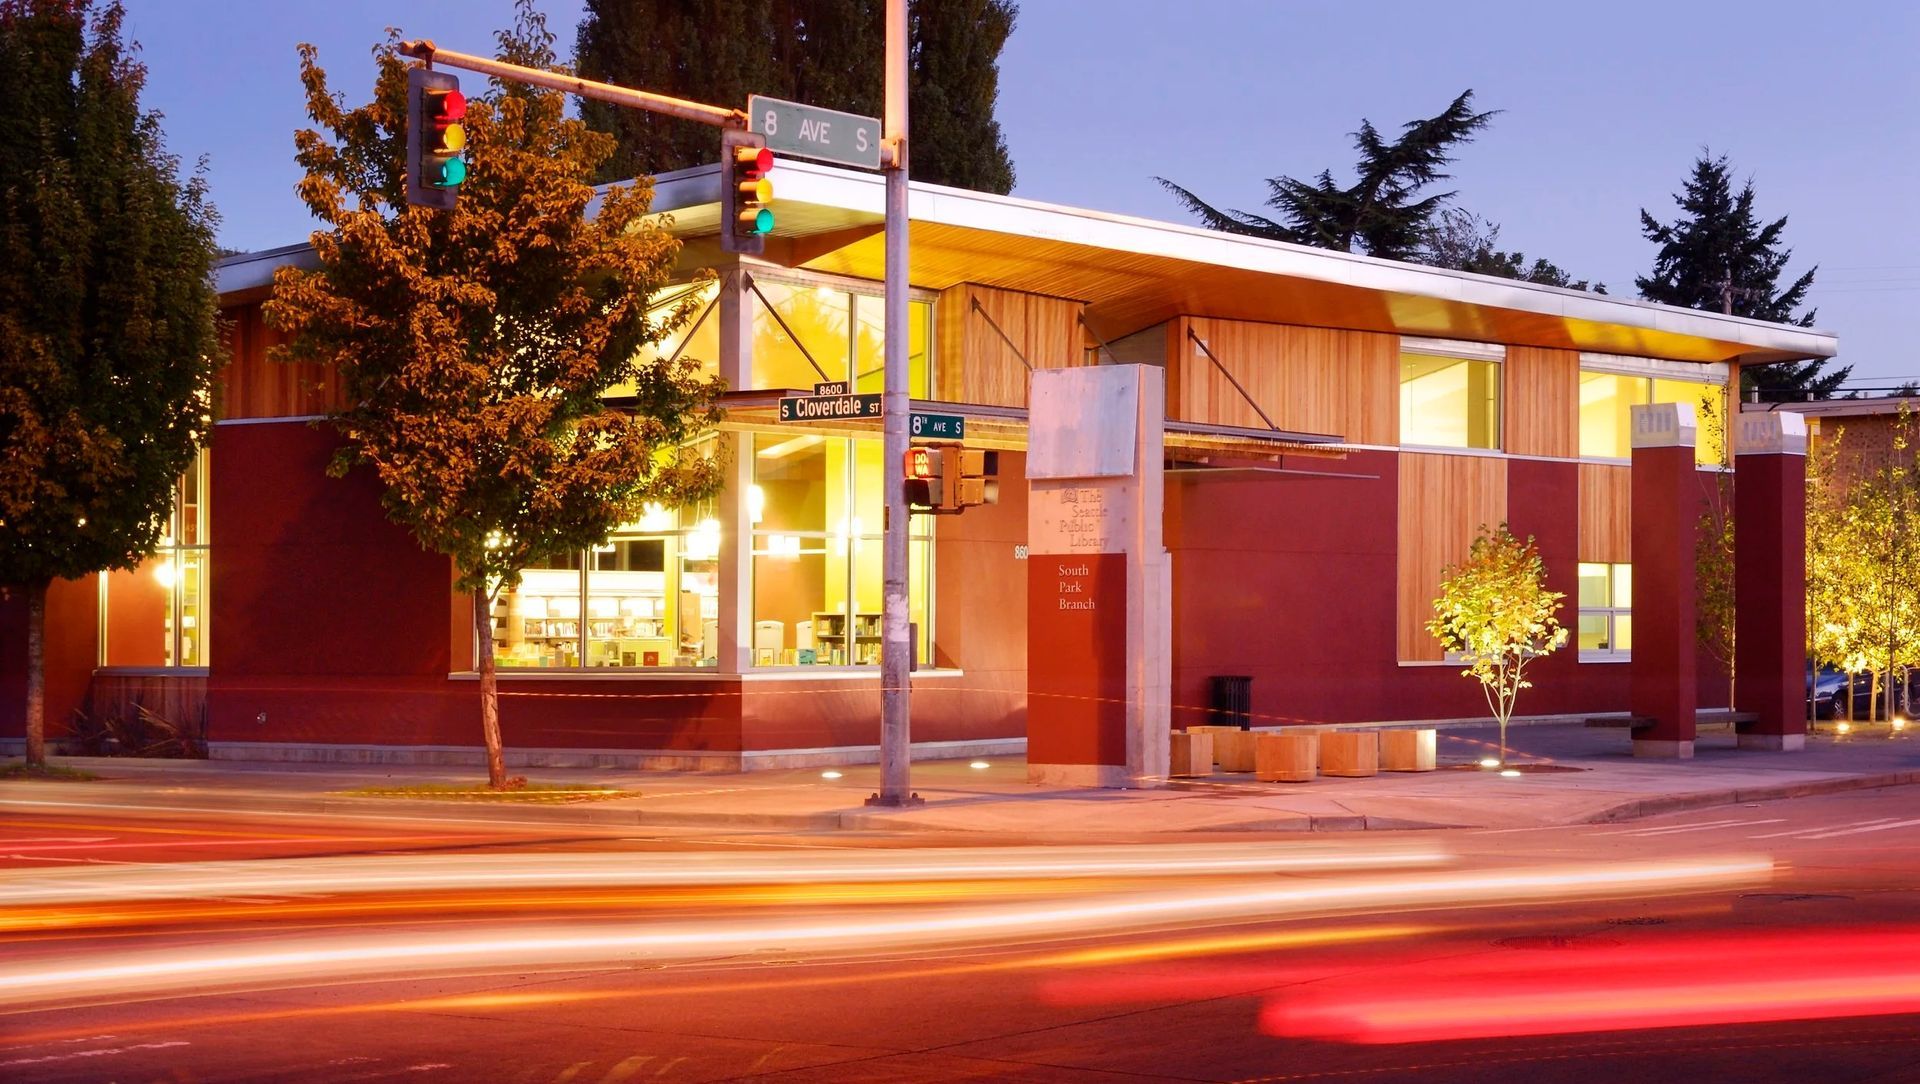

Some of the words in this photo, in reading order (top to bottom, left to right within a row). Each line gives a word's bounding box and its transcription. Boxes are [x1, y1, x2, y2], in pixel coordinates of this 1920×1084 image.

[764, 110, 778, 136] 8
[798, 119, 831, 145] AVE
[855, 127, 868, 152] S
[819, 384, 843, 395] 8600
[781, 404, 789, 418] S
[796, 396, 861, 417] Cloverdale
[869, 402, 880, 413] ST
[933, 422, 947, 432] AVE
[955, 421, 961, 434] S
[1058, 563, 1089, 577] South
[1059, 580, 1082, 593] Park
[1059, 597, 1096, 610] Branch
